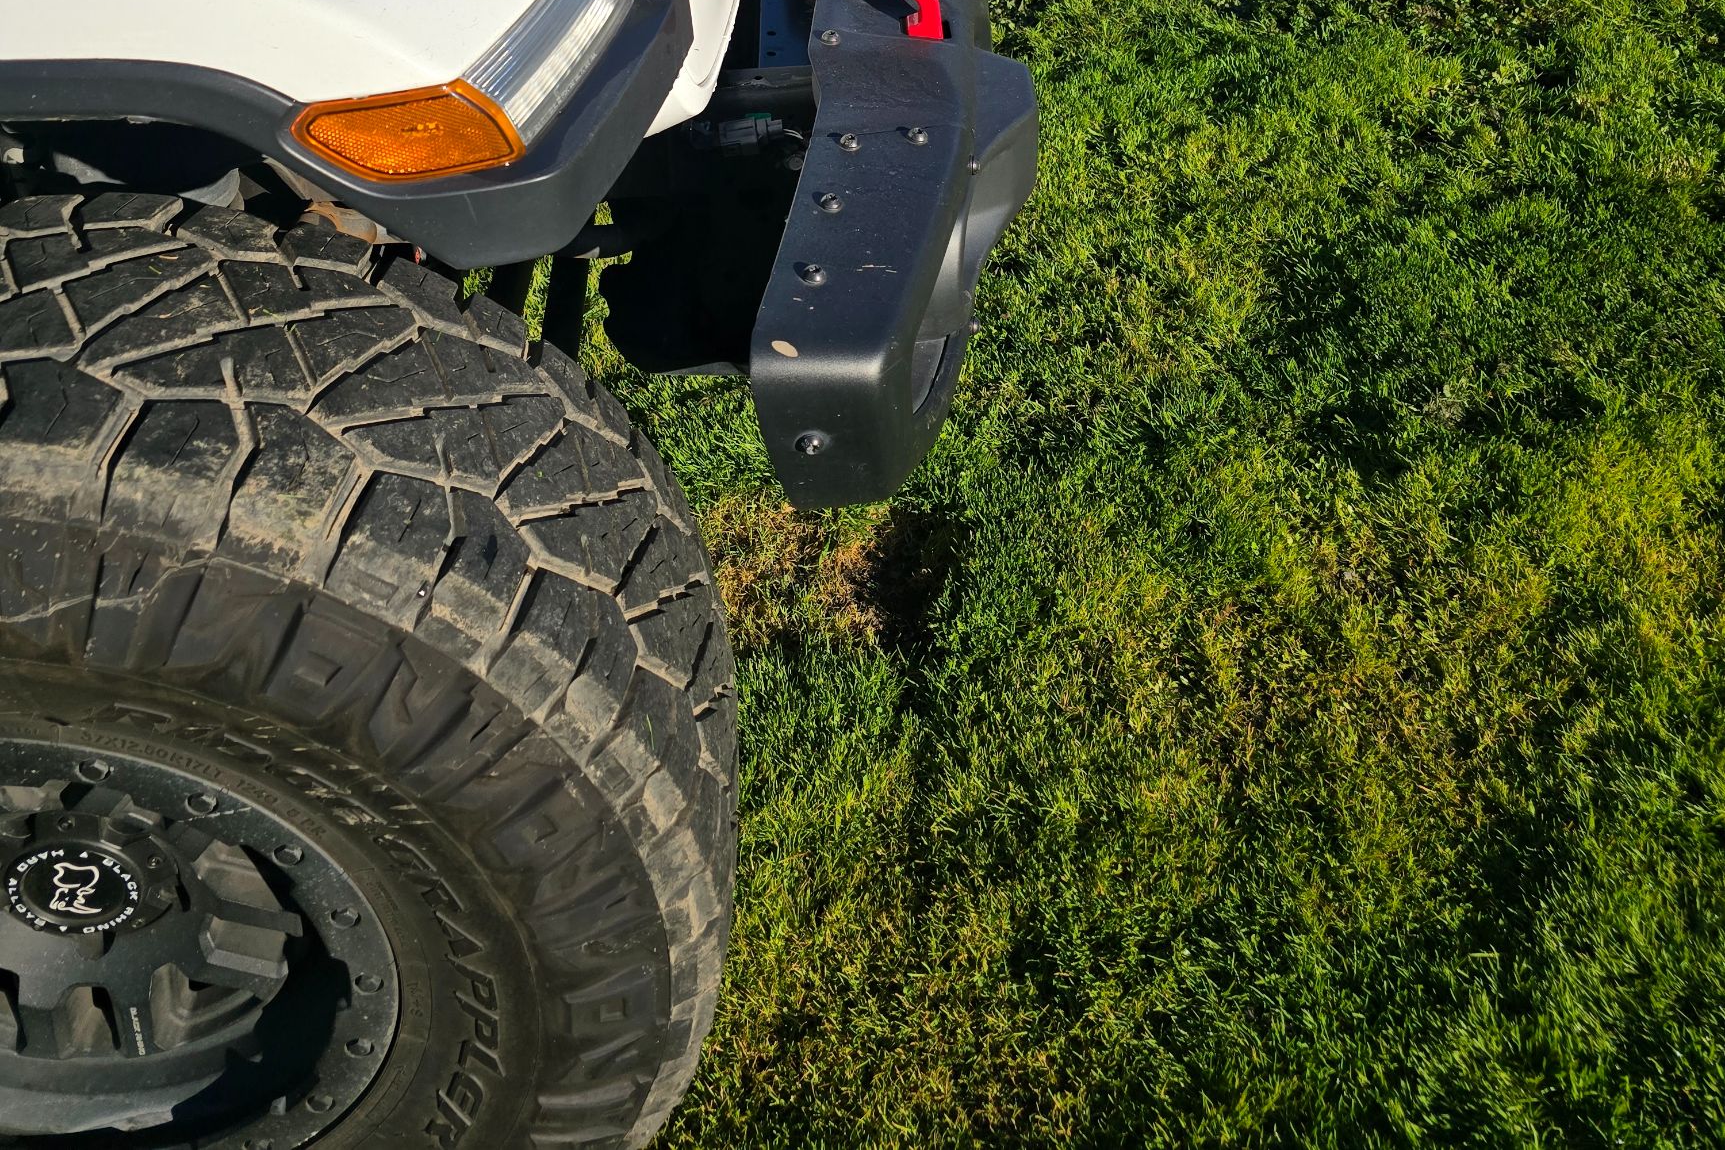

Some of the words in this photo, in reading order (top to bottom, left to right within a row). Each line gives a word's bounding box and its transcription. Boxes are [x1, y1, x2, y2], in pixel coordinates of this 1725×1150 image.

[102, 857, 138, 903] BLACK
[82, 906, 134, 934] RHINO
[373, 834, 506, 1150] GRAPPLER
